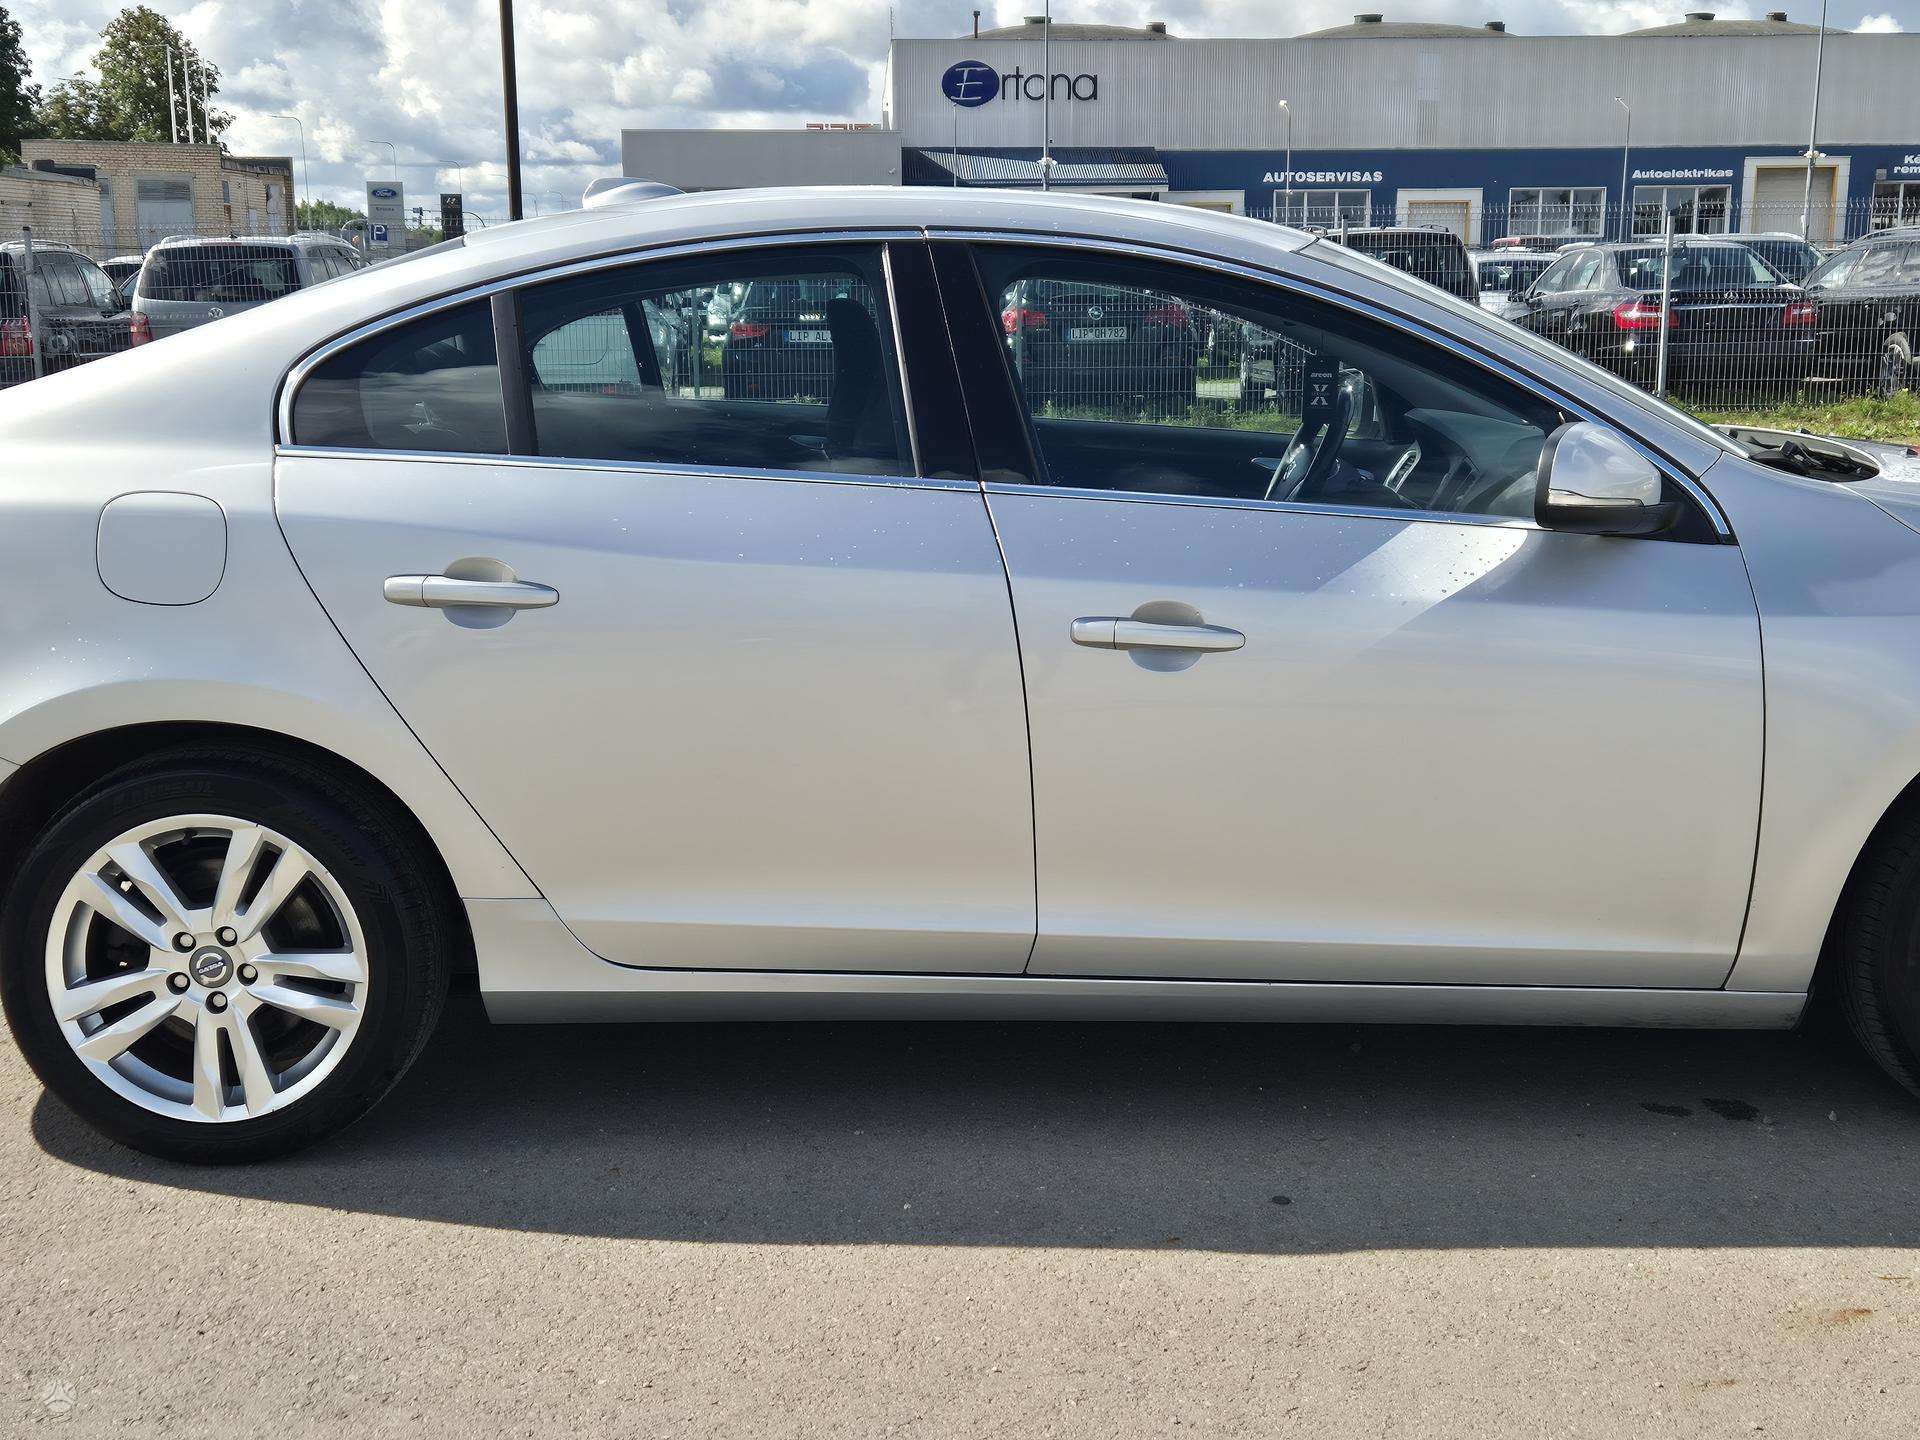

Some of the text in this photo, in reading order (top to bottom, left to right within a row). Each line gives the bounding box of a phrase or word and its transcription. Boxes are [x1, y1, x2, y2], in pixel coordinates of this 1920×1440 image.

[950, 65, 1098, 101] Ertana
[1262, 171, 1383, 182] AUTOSERVISAS
[1631, 168, 1734, 179] Autoelektrikas
[373, 224, 386, 241] P
[790, 331, 809, 341] LIP
[1108, 327, 1125, 338] 782
